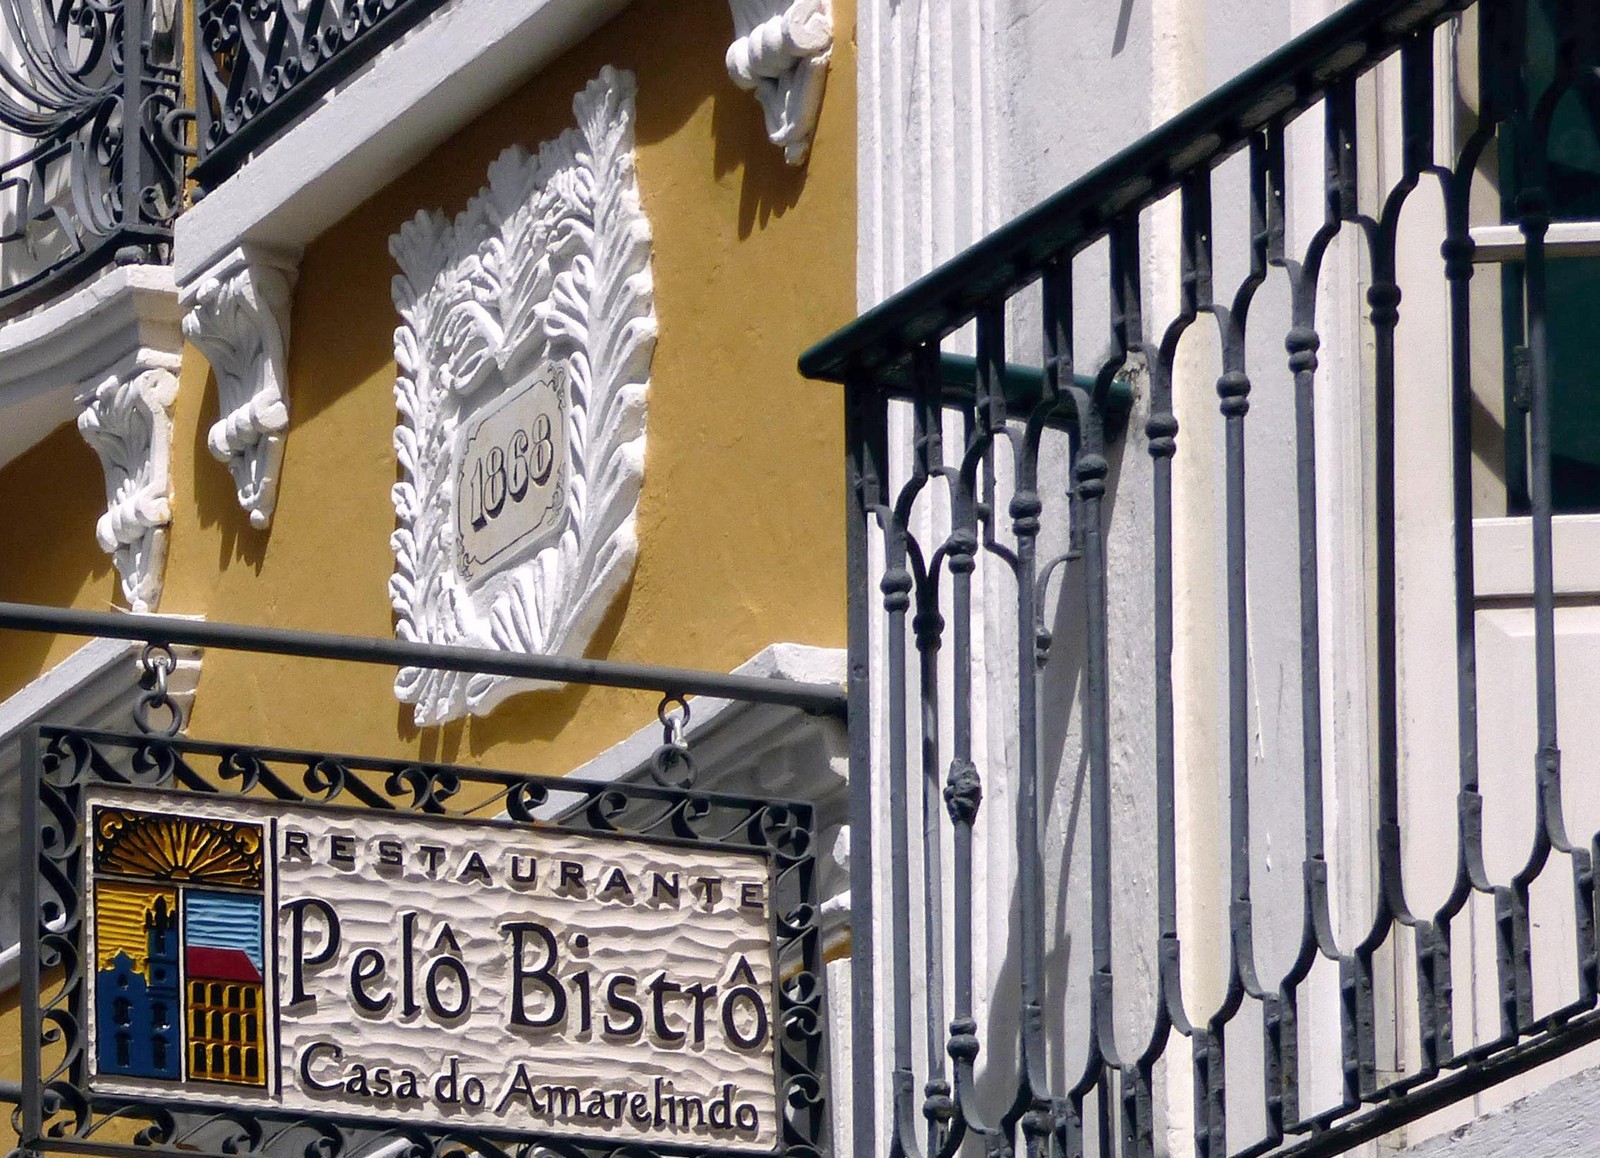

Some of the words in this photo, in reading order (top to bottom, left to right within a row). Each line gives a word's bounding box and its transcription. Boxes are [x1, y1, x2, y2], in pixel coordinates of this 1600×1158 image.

[470, 414, 553, 532] 1868
[283, 831, 765, 909] RESTAURANTE
[282, 898, 472, 1020] Pelô
[502, 921, 767, 1050] Bistrô
[300, 1040, 417, 1099] Casa
[434, 1057, 484, 1107] do
[495, 1063, 759, 1133] Amarelindo
